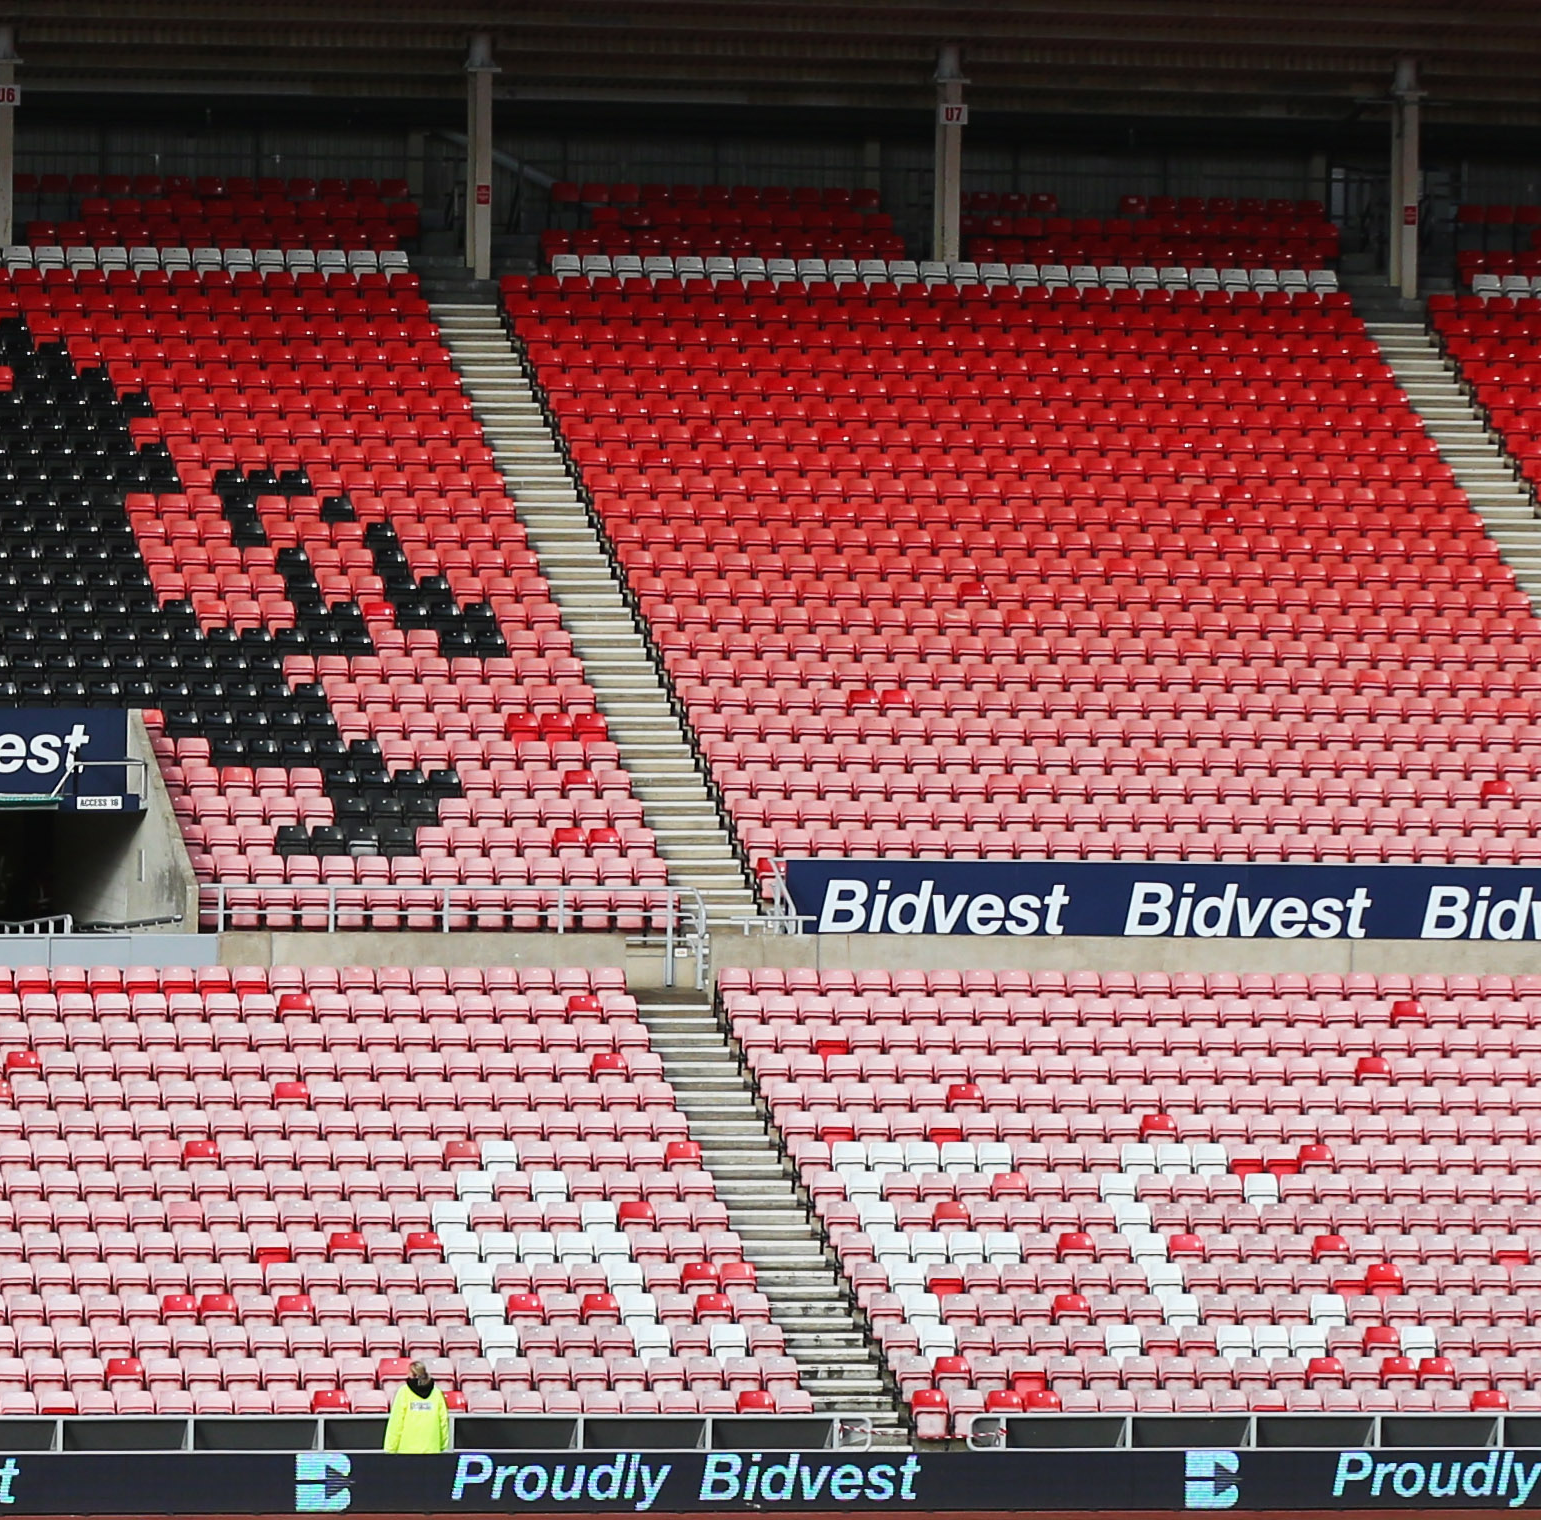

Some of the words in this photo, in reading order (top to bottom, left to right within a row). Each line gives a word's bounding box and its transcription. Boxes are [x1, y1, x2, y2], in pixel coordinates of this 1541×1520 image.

[944, 107, 963, 121] U7
[817, 879, 1070, 936] Bidvest
[1123, 882, 1372, 939] Bidvest
[1420, 885, 1541, 940] Bid
[451, 1452, 672, 1511] Proudly
[699, 1452, 922, 1500] Bidvest
[1332, 1451, 1541, 1508] Proudly
